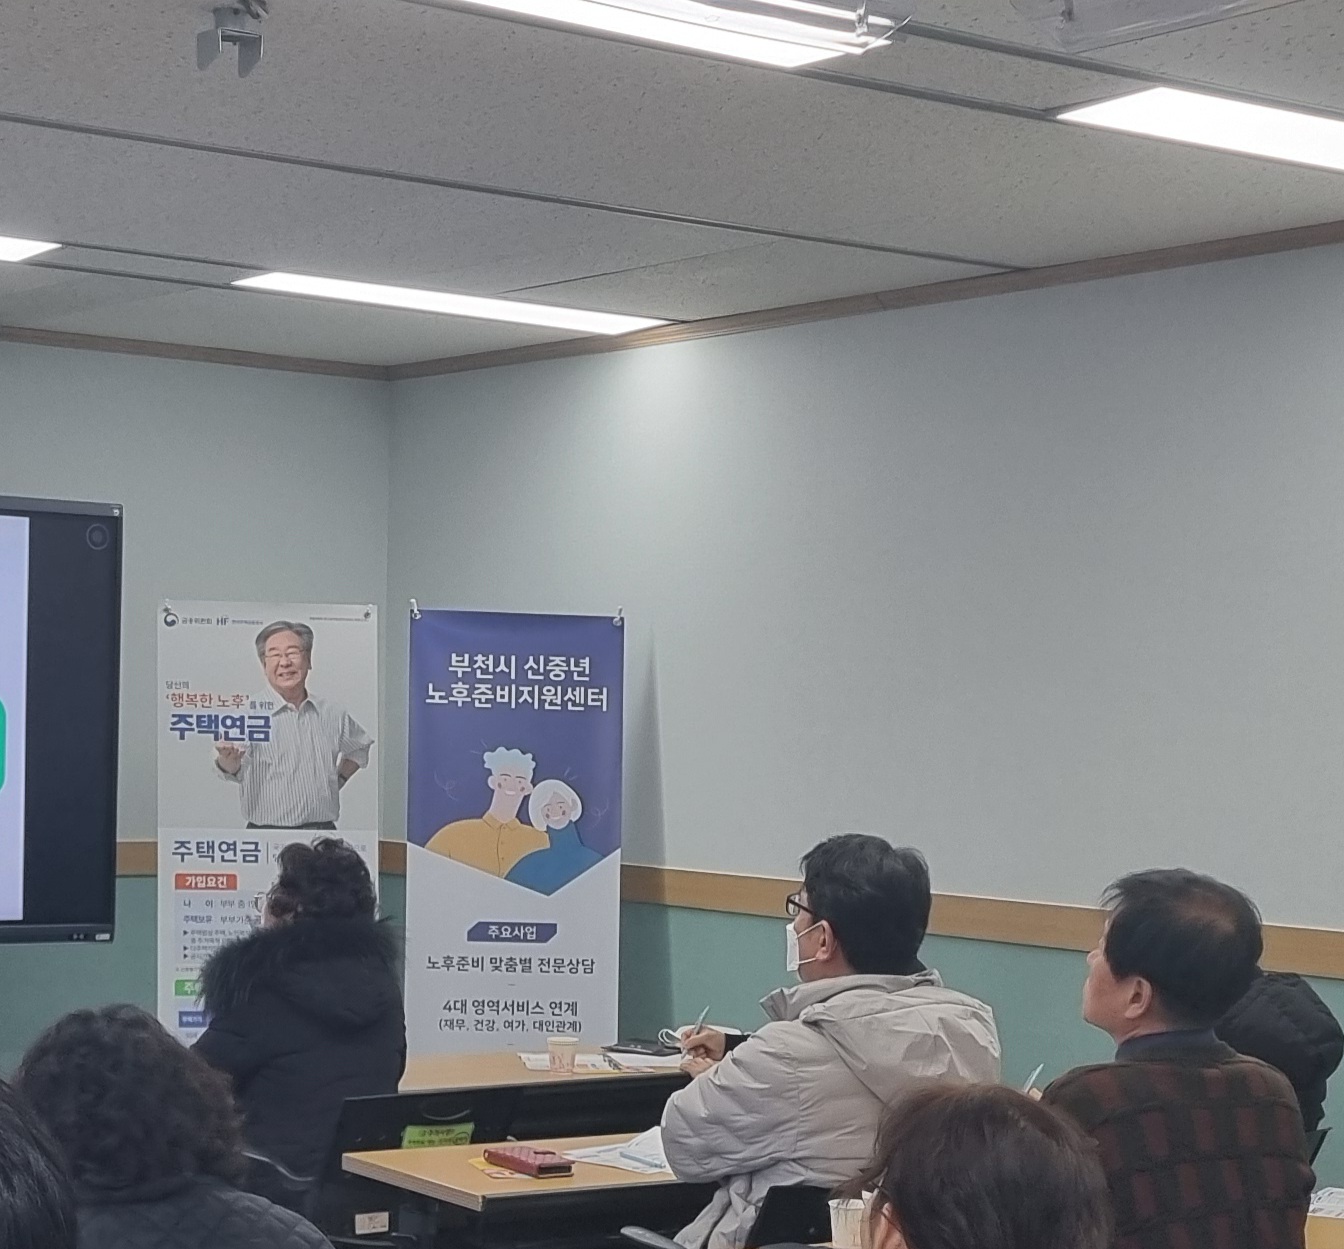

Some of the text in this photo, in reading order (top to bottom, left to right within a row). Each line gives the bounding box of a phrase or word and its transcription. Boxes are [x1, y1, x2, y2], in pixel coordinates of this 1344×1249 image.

[448, 653, 590, 681] 부천시 신중년
[165, 680, 190, 690] 당신의
[425, 682, 608, 712] 노후준비지원센터
[169, 713, 272, 742] 주택연금
[171, 840, 262, 864] 주택연금
[185, 876, 227, 888] 가입요건
[487, 925, 537, 940] 주요사업
[426, 955, 596, 974] 노후준비 맞춤별 전문상담
[442, 999, 578, 1016] 4대 영역서비스 연계
[439, 1018, 582, 1033] (재무, 건강, 여가, 대인관계)
